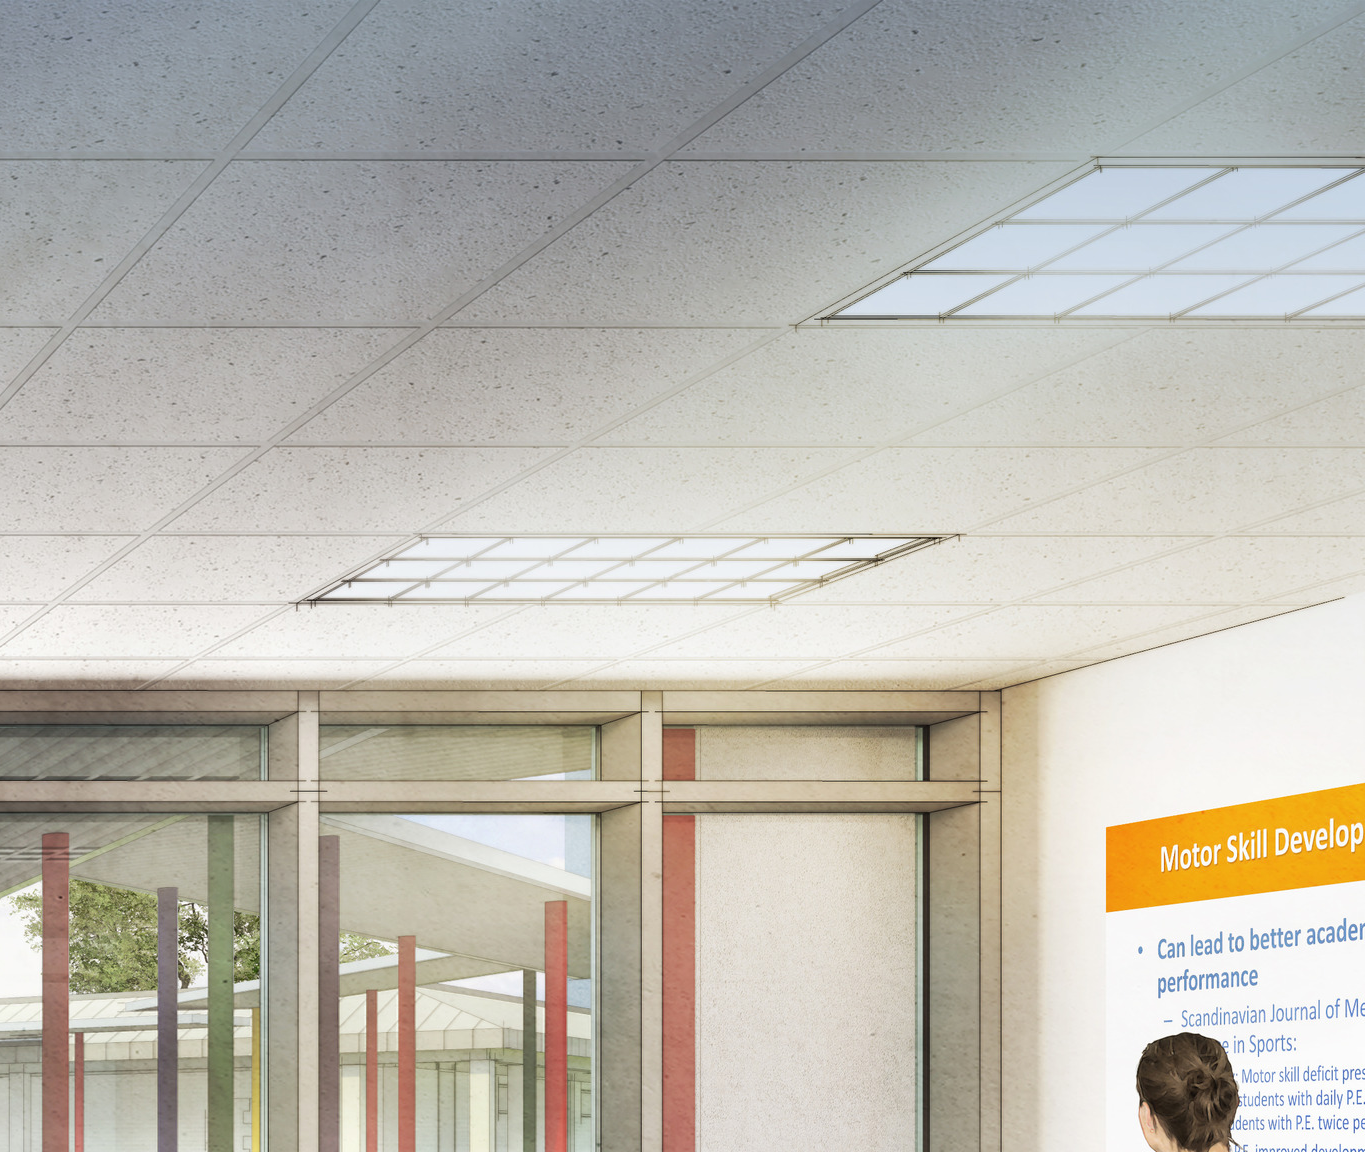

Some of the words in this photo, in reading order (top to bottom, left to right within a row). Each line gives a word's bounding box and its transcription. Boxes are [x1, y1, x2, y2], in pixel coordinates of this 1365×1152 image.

[1161, 843, 1221, 873] Motor
[1226, 828, 1268, 864] Skill
[1275, 818, 1364, 856] Develop
[1158, 938, 1185, 960] Can
[1191, 931, 1223, 957] lead
[1228, 932, 1245, 953] to
[1250, 927, 1302, 951] better
[1158, 968, 1259, 999] performance
[1181, 1004, 1266, 1028] Scandinavian
[1270, 1000, 1321, 1023] Journal
[1325, 998, 1341, 1019] of
[1233, 1035, 1245, 1054] in
[1249, 1034, 1297, 1057] Sports:
[1242, 1068, 1276, 1083] Motor
[1279, 1066, 1300, 1082] skill
[1303, 1065, 1339, 1082] deficit
[1238, 1090, 1285, 1107] students
[1288, 1090, 1312, 1106] with
[1316, 1089, 1343, 1109] daily
[1347, 1089, 1365, 1105] P.E.
[1268, 1114, 1292, 1131] with
[1296, 1114, 1315, 1130] P.E.
[1318, 1114, 1349, 1130] twice
